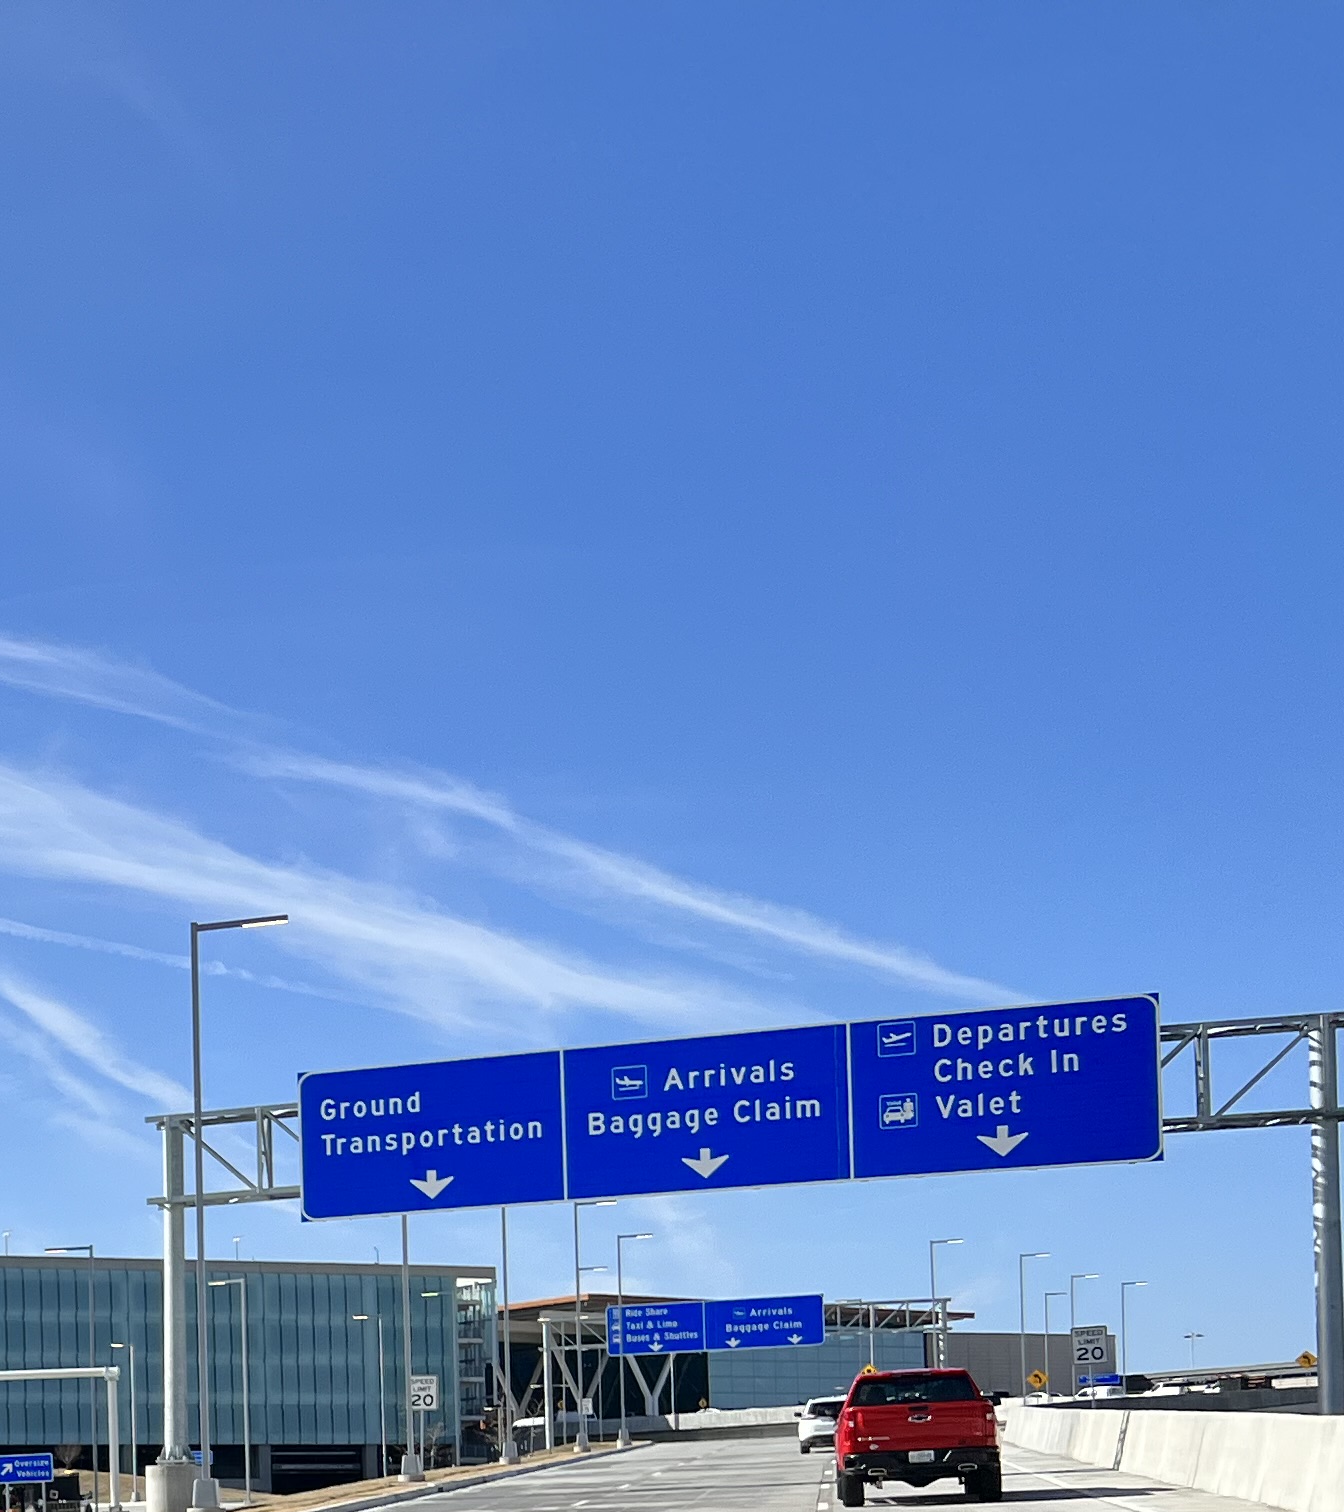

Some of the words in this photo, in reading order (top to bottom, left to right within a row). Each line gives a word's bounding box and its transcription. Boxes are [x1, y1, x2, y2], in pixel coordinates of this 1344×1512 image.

[933, 1013, 1127, 1050] Departures
[934, 1052, 1034, 1083] Check
[1050, 1049, 1079, 1073] In
[664, 1059, 794, 1092] Arrivals
[320, 1091, 421, 1121] Ground
[936, 1090, 1021, 1119] Valet
[588, 1107, 719, 1138] Baggage
[733, 1096, 821, 1122] Claim
[320, 1119, 542, 1156] Transportation
[625, 1308, 643, 1318] Ride
[645, 1307, 669, 1316] Share
[749, 1306, 793, 1317] Arrivals
[626, 1321, 644, 1330] Taxi
[646, 1320, 654, 1329] &
[657, 1319, 678, 1328] Limo
[725, 1323, 770, 1333] Baggage
[773, 1320, 803, 1330] Claim
[626, 1333, 650, 1343] Buses
[653, 1332, 661, 1341] &
[664, 1331, 699, 1341] Shuttles
[1074, 1329, 1104, 1338] SPEED
[1076, 1346, 1104, 1361] 20
[412, 1394, 433, 1406] 20
[14, 1459, 50, 1468] Oversize
[16, 1469, 50, 1478] Vehicles
